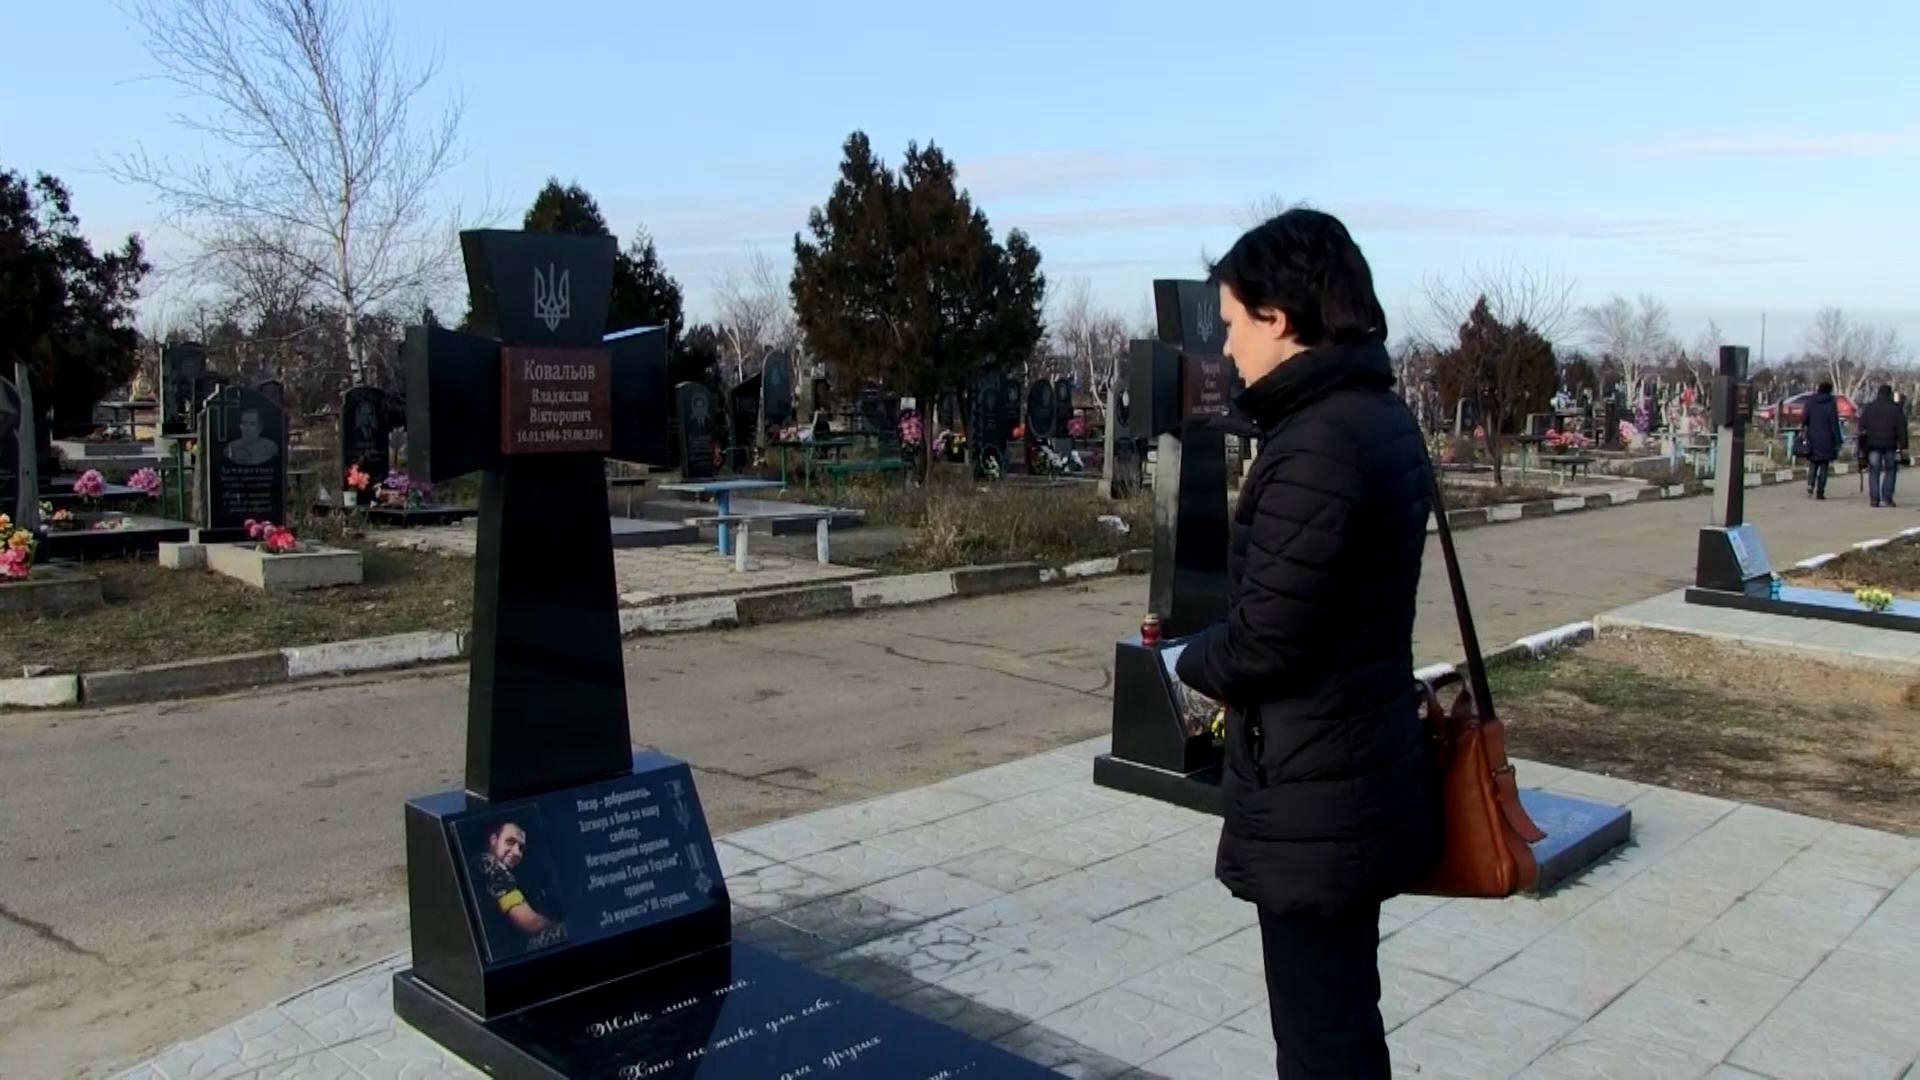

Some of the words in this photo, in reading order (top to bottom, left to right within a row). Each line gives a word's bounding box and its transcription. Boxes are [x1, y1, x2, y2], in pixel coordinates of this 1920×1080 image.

[524, 359, 596, 381] Ковальов
[532, 387, 590, 406] Владислав
[529, 407, 592, 426] Вікторович
[586, 1011, 652, 1038] Живе
[618, 1059, 674, 1080] Хто
[686, 1047, 708, 1060] не
[713, 1027, 757, 1048] живе
[765, 1015, 797, 1033] для
[822, 1036, 881, 1070] других
